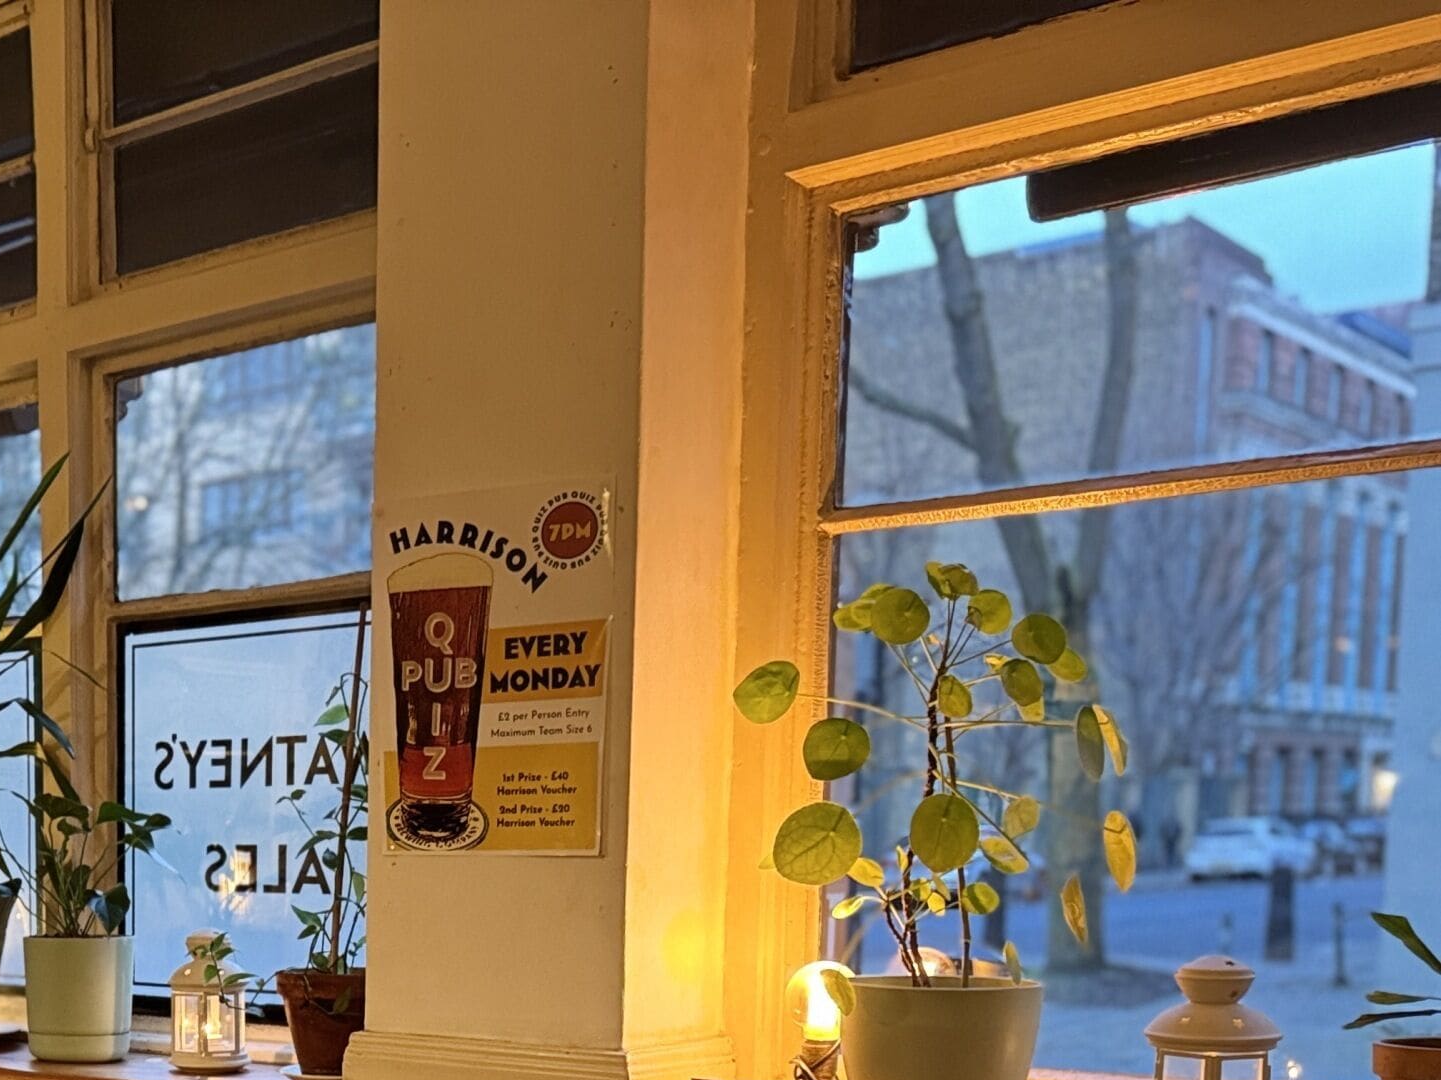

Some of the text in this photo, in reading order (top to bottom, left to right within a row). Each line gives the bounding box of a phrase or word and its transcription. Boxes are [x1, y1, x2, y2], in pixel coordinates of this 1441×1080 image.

[571, 491, 596, 504] QUIZ
[389, 520, 548, 594] HARRISON
[504, 631, 588, 660] EVERY
[401, 657, 478, 694] PUB
[490, 664, 602, 694] MONDAY
[498, 708, 591, 723] £2 per Person Entry
[491, 724, 593, 738] Maximum Team Size 6
[502, 773, 515, 783] 1st
[518, 772, 542, 782] Prize
[497, 784, 578, 796] Harrison Voucher
[499, 803, 517, 814] 2nd
[520, 804, 543, 814] Prize
[551, 803, 570, 813] £20
[497, 816, 576, 828] Harrison Voucher
